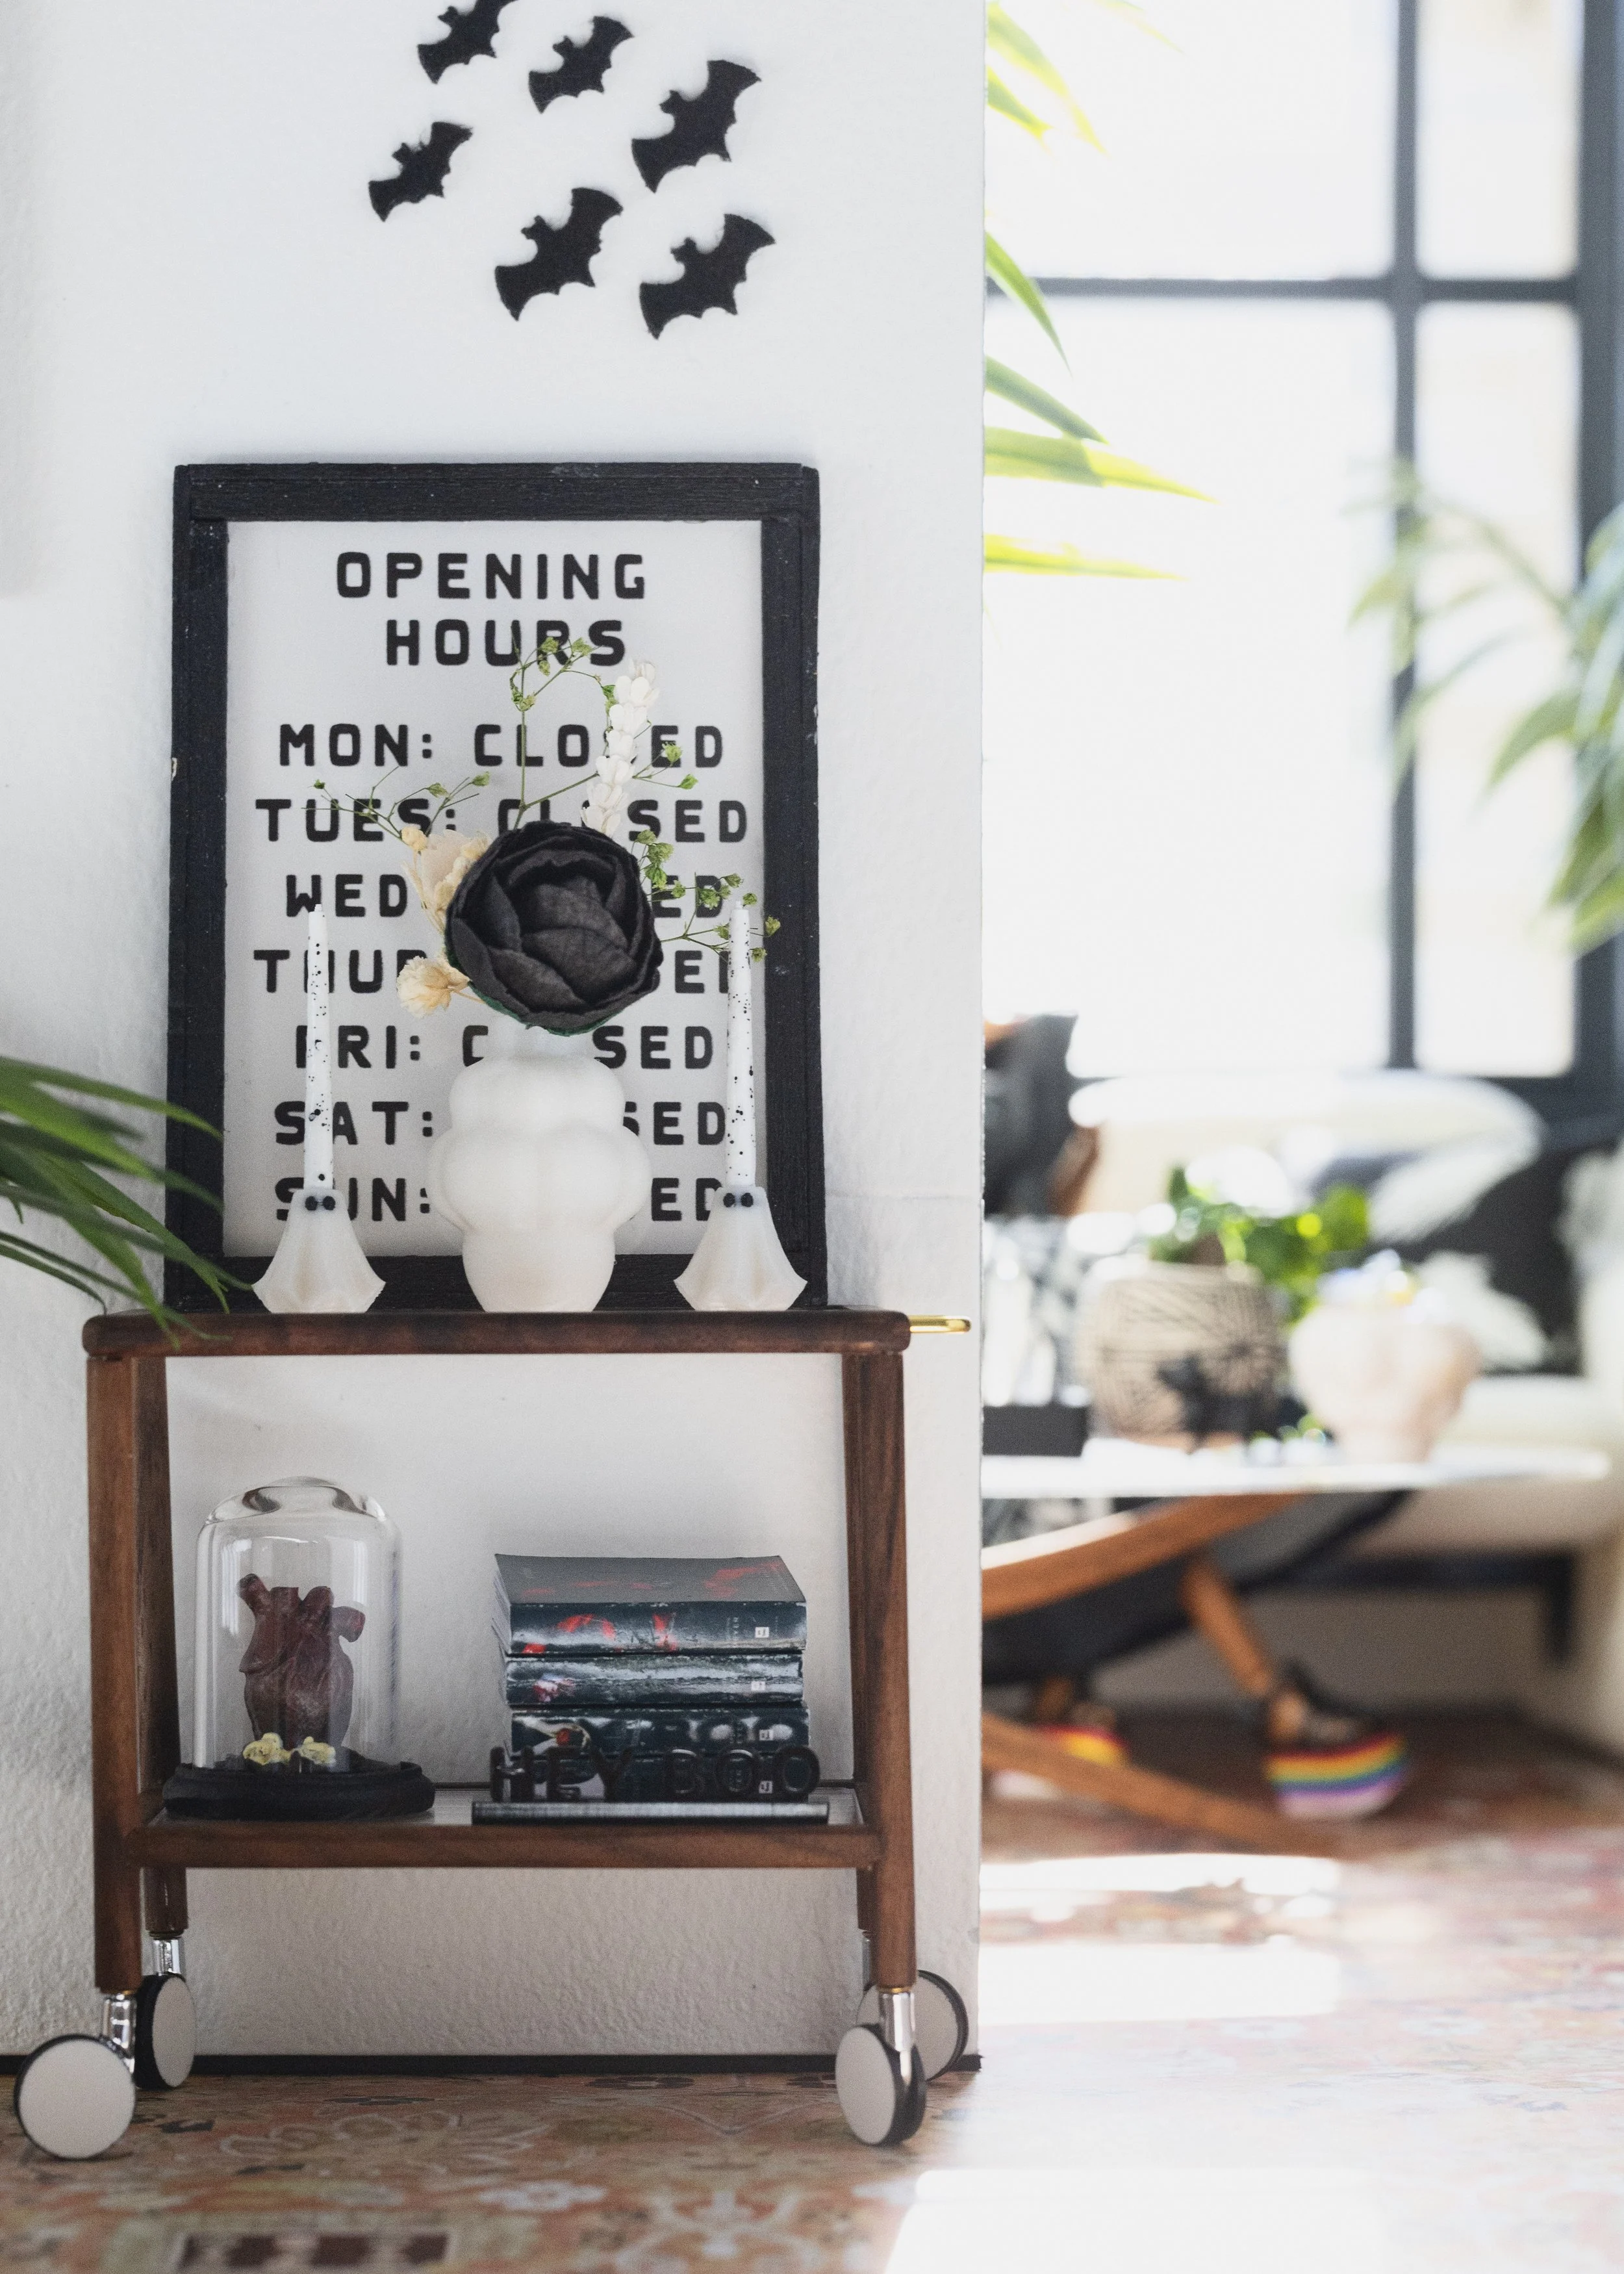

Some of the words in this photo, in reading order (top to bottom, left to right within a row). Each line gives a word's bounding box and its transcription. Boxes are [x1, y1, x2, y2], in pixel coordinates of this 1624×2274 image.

[336, 552, 644, 600] OPENING
[387, 619, 626, 666] HOURS
[280, 724, 432, 766] MON:
[474, 724, 723, 768] CLOED
[463, 1025, 713, 1069] CSED
[490, 1746, 632, 1802] HEY
